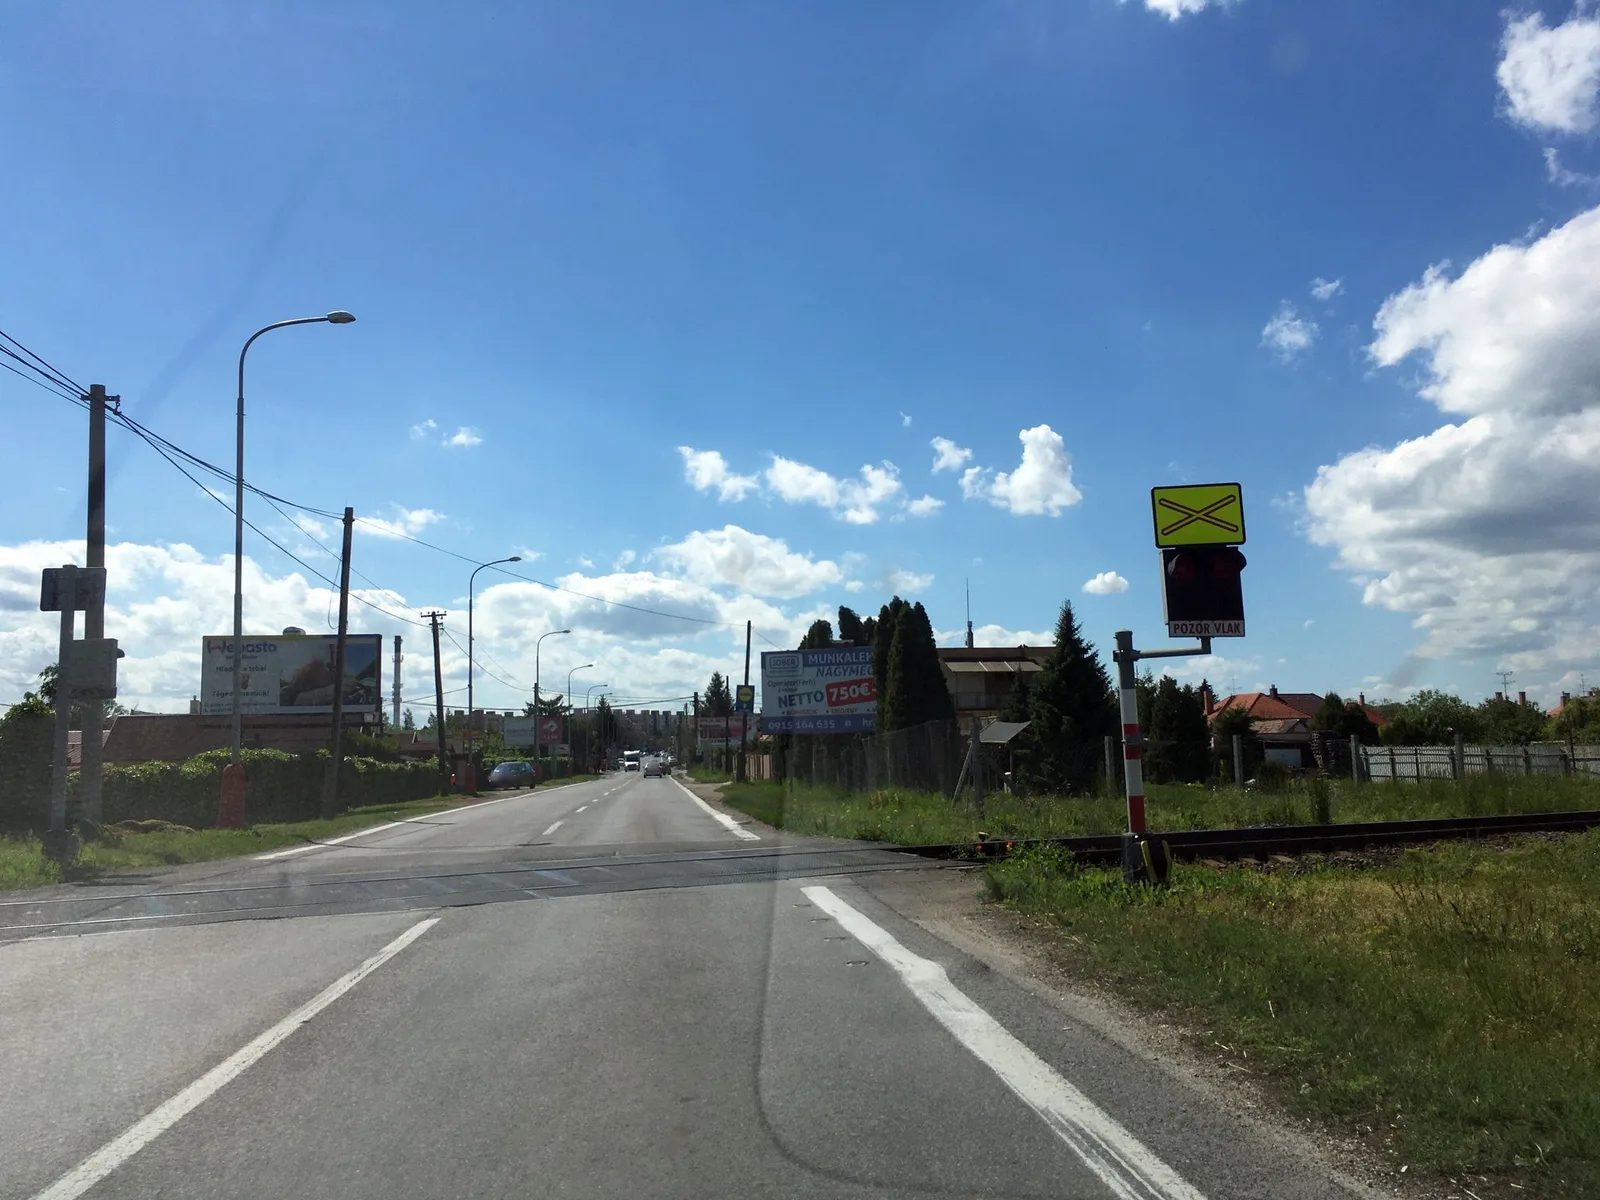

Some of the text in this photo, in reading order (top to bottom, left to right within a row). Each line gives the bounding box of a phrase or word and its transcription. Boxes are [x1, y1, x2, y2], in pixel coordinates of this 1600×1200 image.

[1174, 623, 1241, 634] POZOR VLAK
[778, 682, 871, 708] NETTO 750€
[768, 721, 793, 730] 0915
[795, 720, 814, 729] 164
[816, 719, 836, 729] 635
